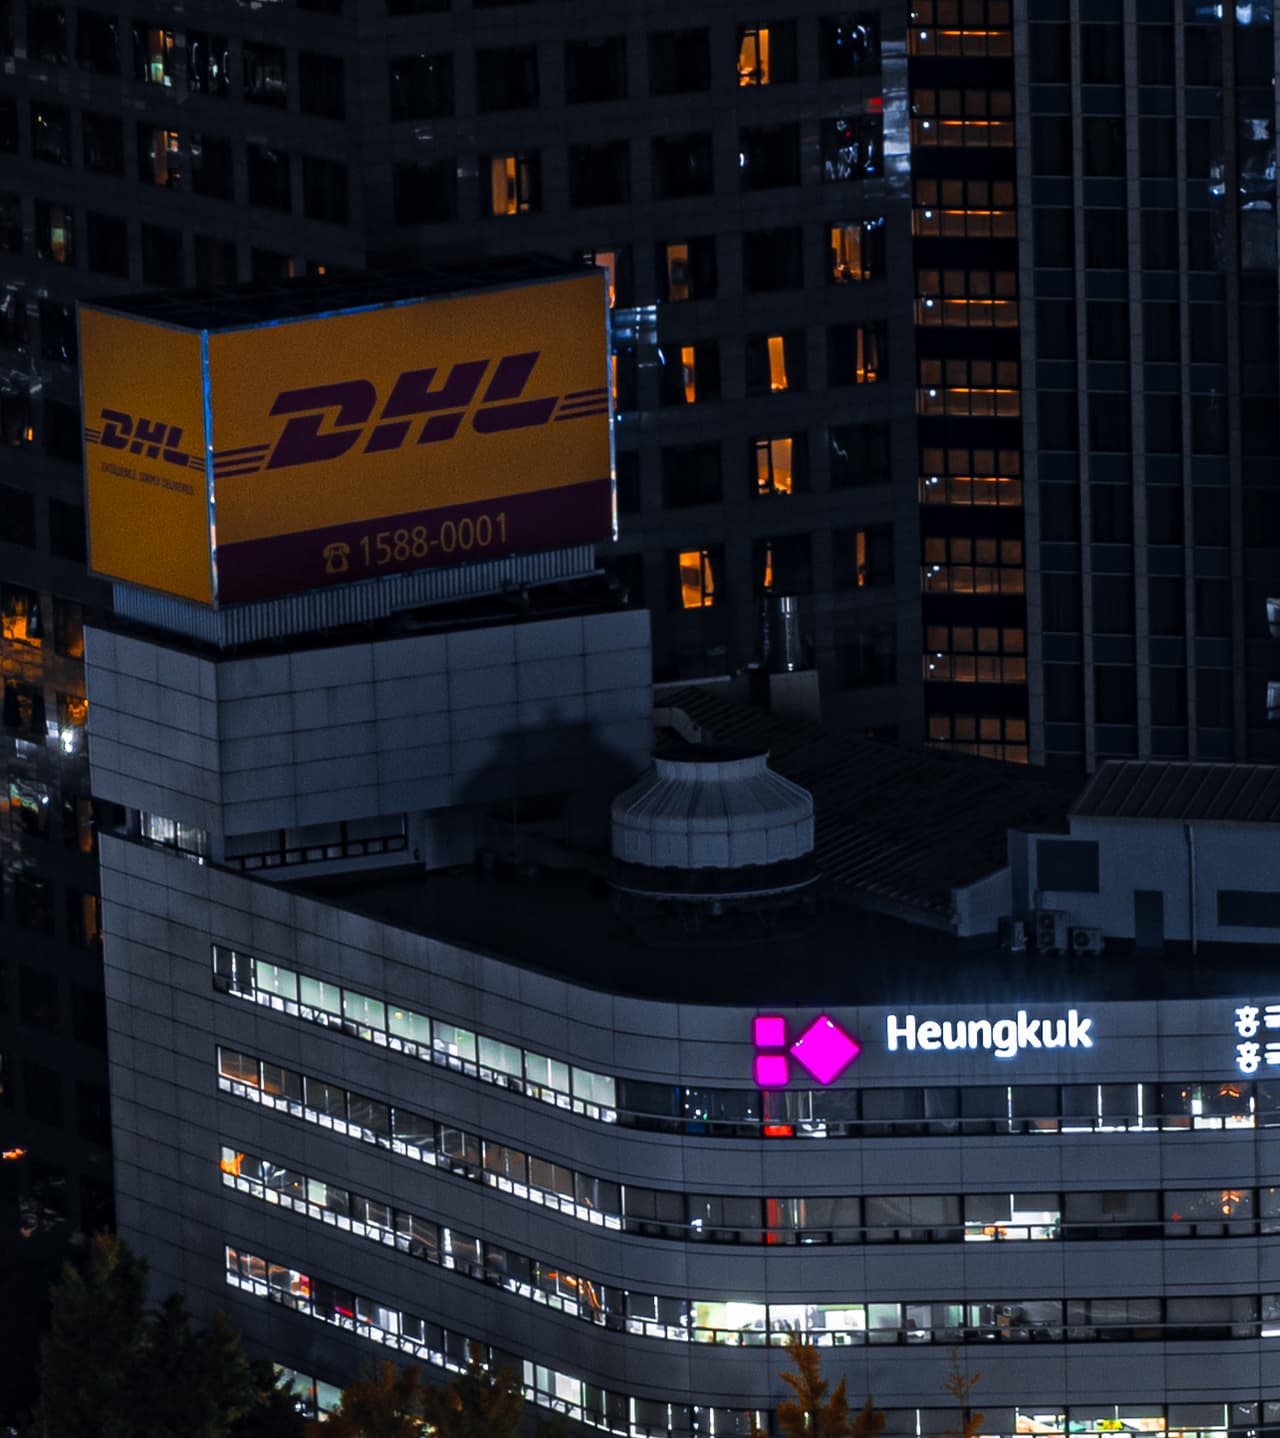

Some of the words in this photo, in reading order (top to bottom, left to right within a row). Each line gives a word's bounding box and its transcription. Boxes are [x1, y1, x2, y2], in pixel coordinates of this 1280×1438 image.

[101, 408, 190, 467] DHL
[266, 350, 559, 470] DHL
[359, 511, 508, 568] 1588-0001
[887, 1009, 1093, 1058] Heungkuk
